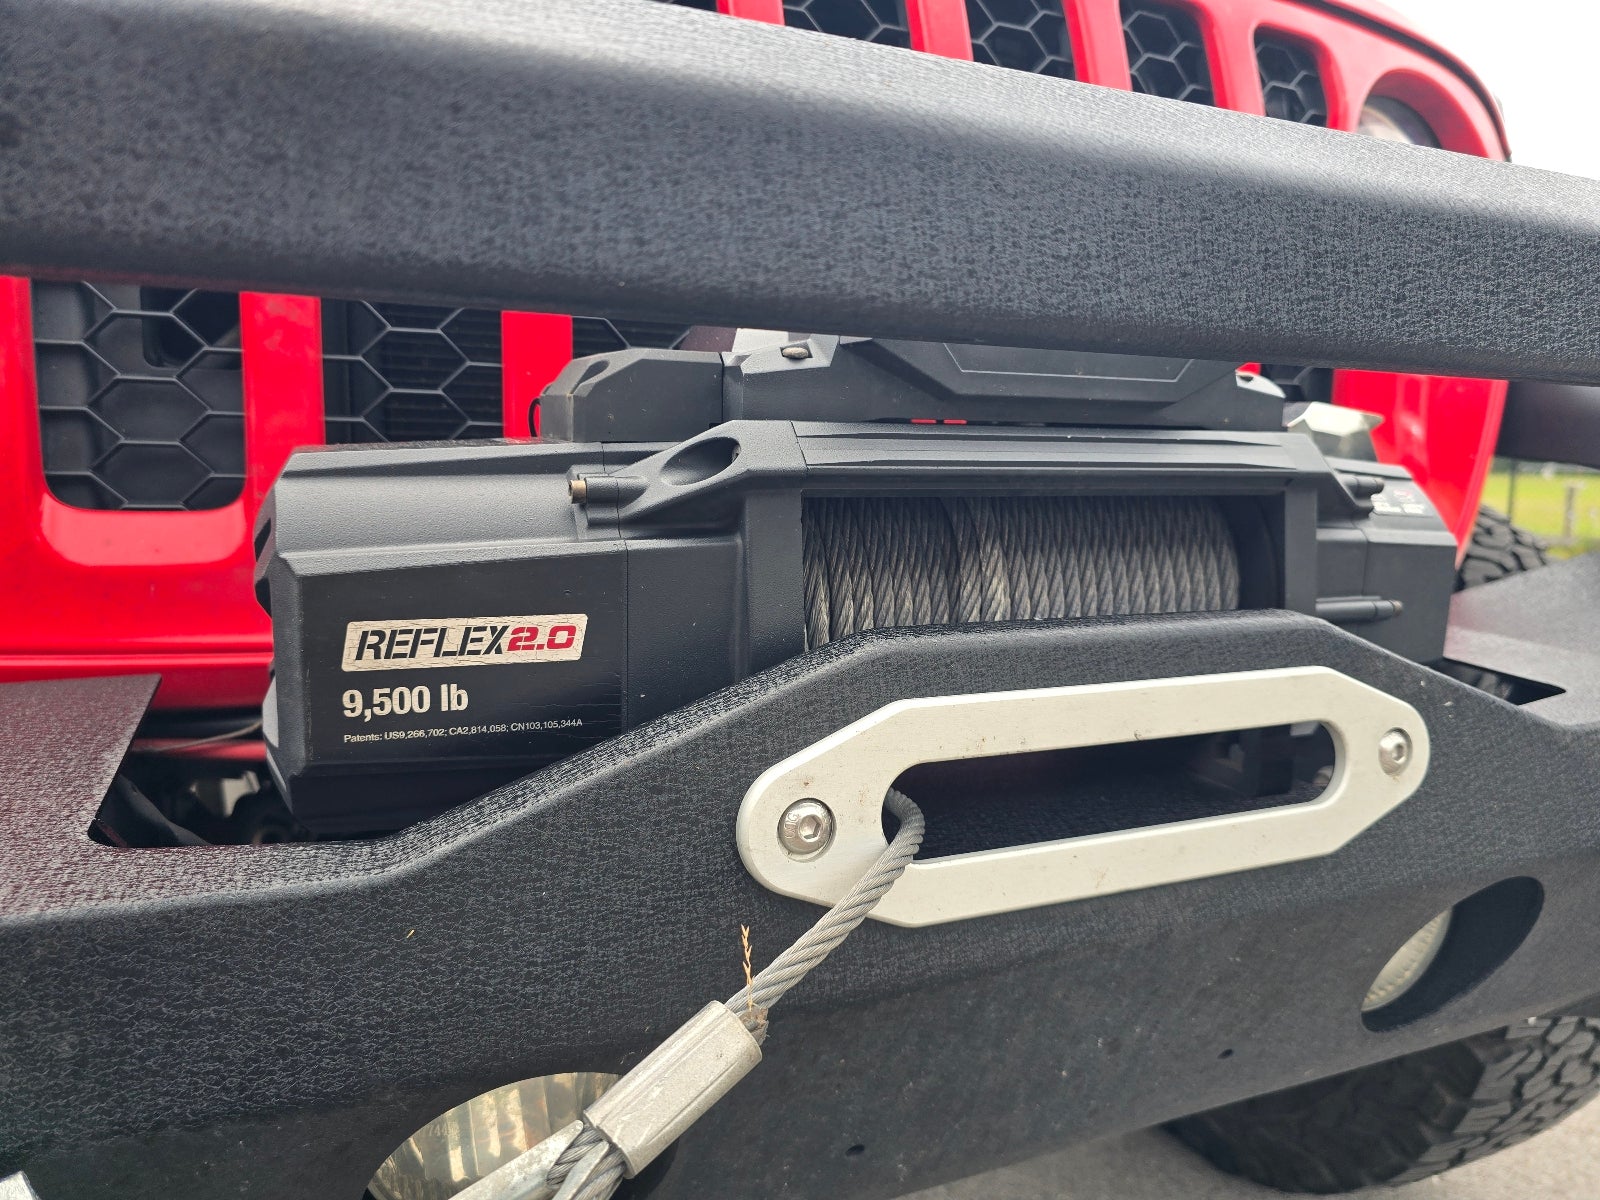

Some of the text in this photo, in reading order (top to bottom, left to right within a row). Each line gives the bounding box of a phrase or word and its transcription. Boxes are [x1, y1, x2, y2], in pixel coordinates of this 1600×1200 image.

[342, 683, 469, 722] 9,500 lb
[344, 718, 583, 743] Patents: US9,266,702; CA2,814,058; CN103,105,344A
